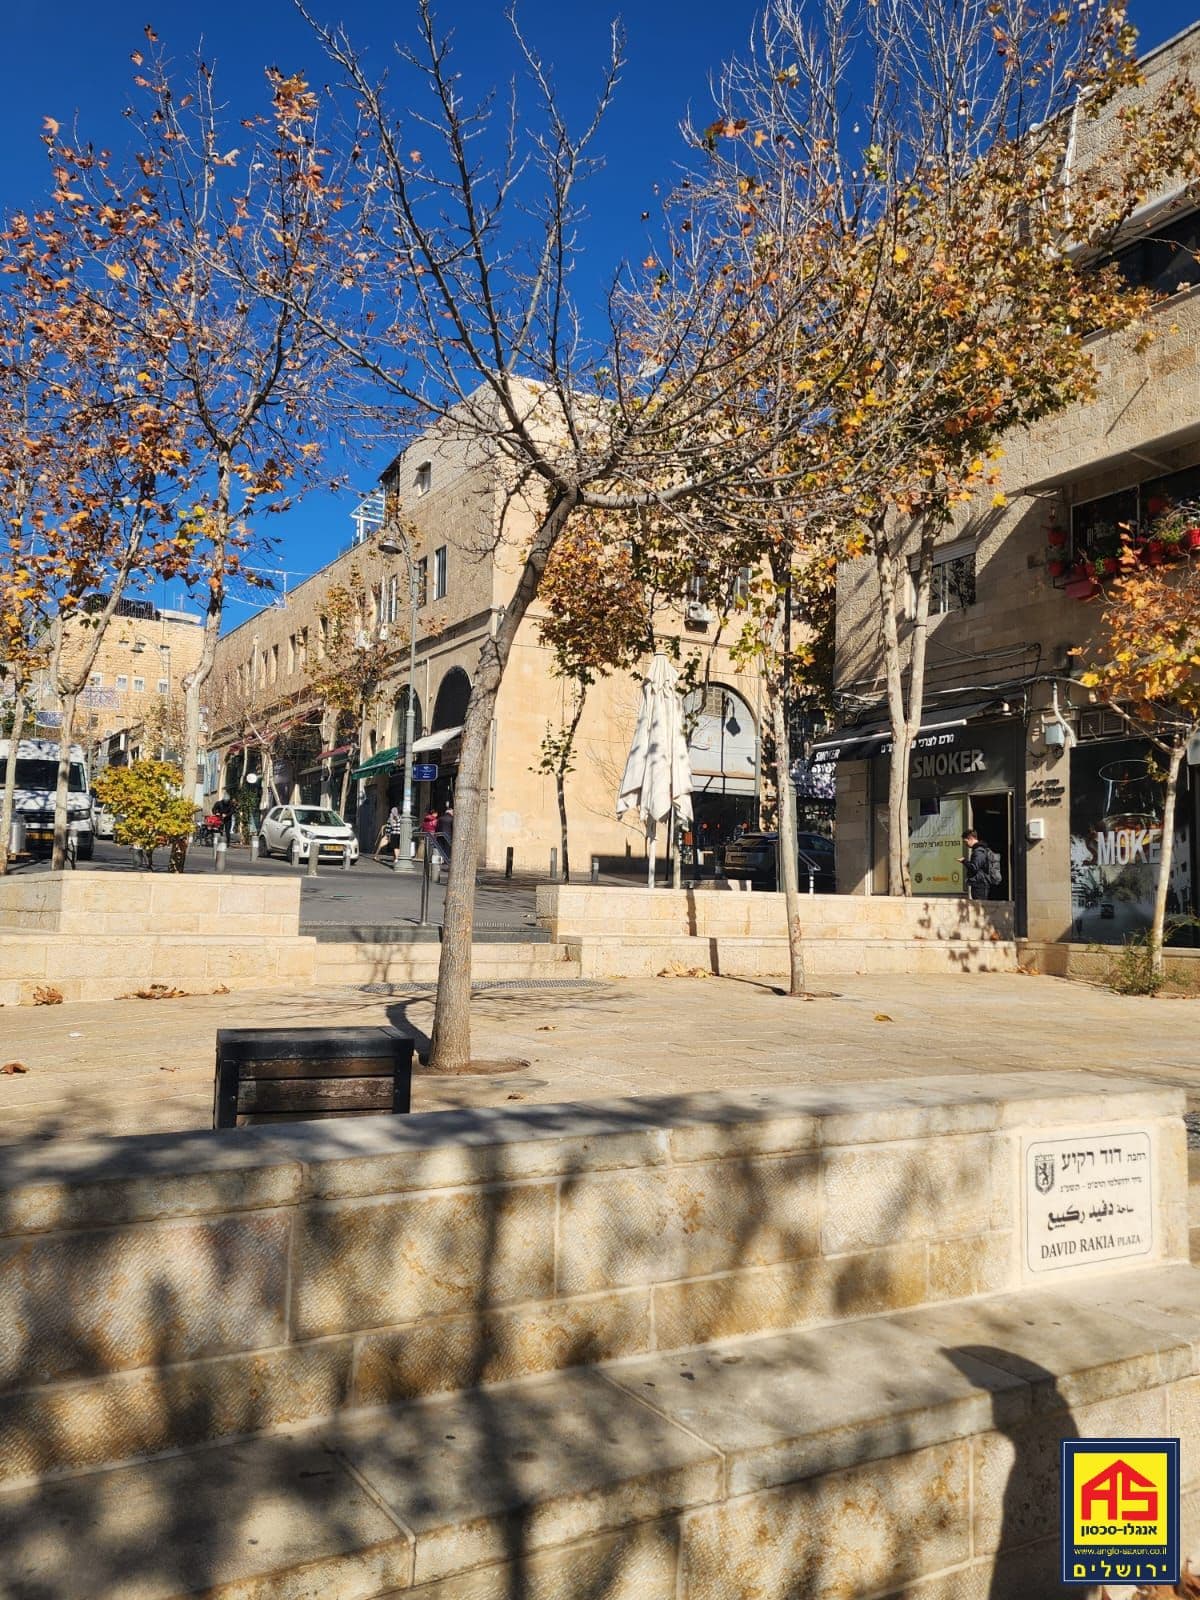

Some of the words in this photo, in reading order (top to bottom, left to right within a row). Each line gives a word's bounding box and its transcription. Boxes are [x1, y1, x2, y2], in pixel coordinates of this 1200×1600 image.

[911, 748, 987, 779] SMOKER
[1100, 1148, 1122, 1165] דוד
[1040, 1240, 1077, 1259] DAVID
[1080, 1235, 1115, 1253] RAKIA
[1117, 1234, 1142, 1247] PLAZA
